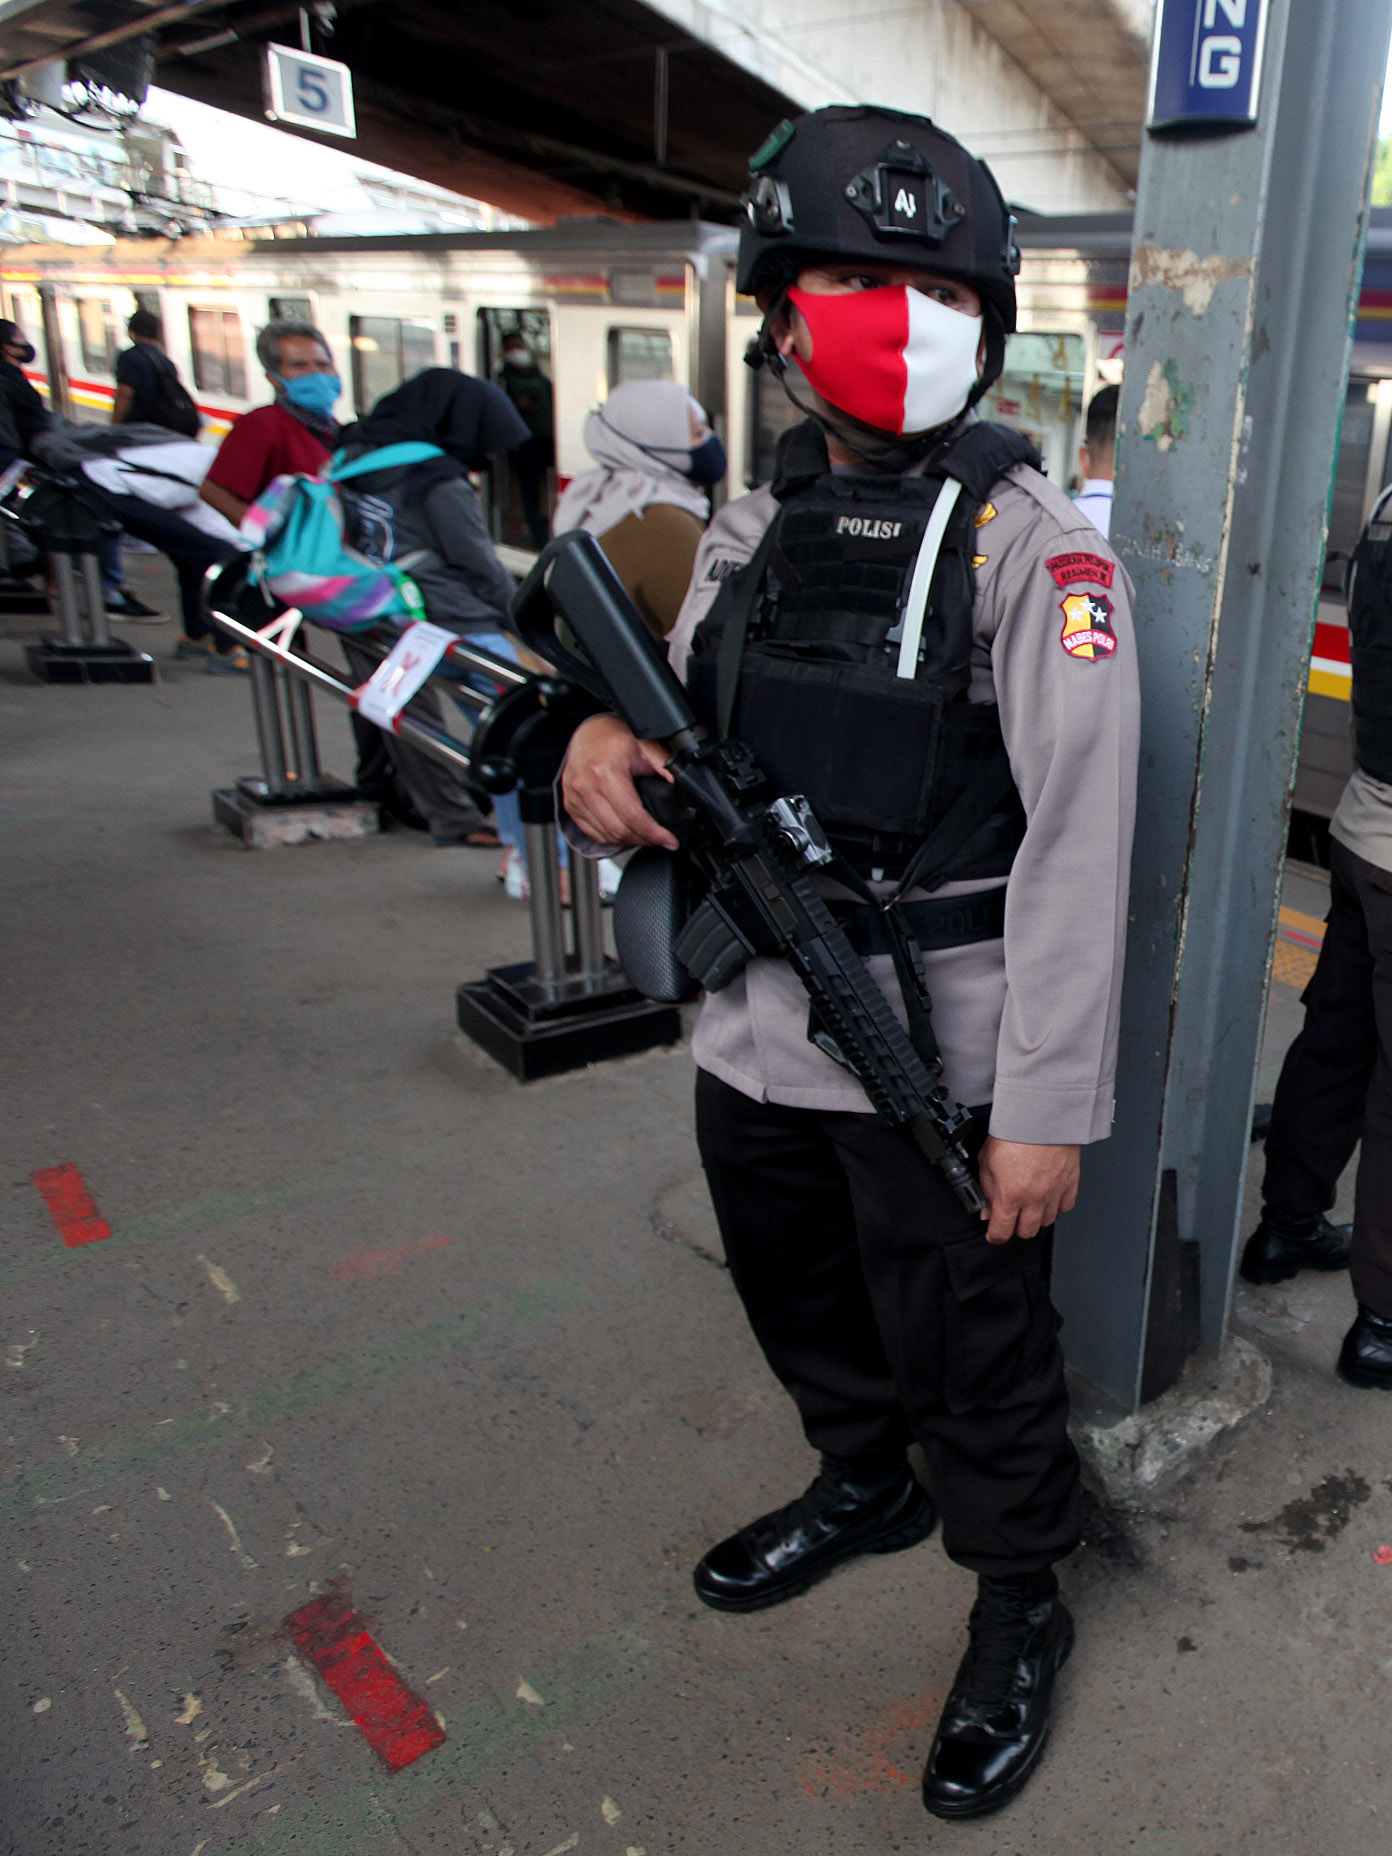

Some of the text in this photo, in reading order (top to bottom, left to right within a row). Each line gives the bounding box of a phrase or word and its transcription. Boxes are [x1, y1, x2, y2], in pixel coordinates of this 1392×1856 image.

[298, 67, 329, 113] 5
[836, 515, 903, 540] POLISI
[1062, 630, 1092, 651] MABES
